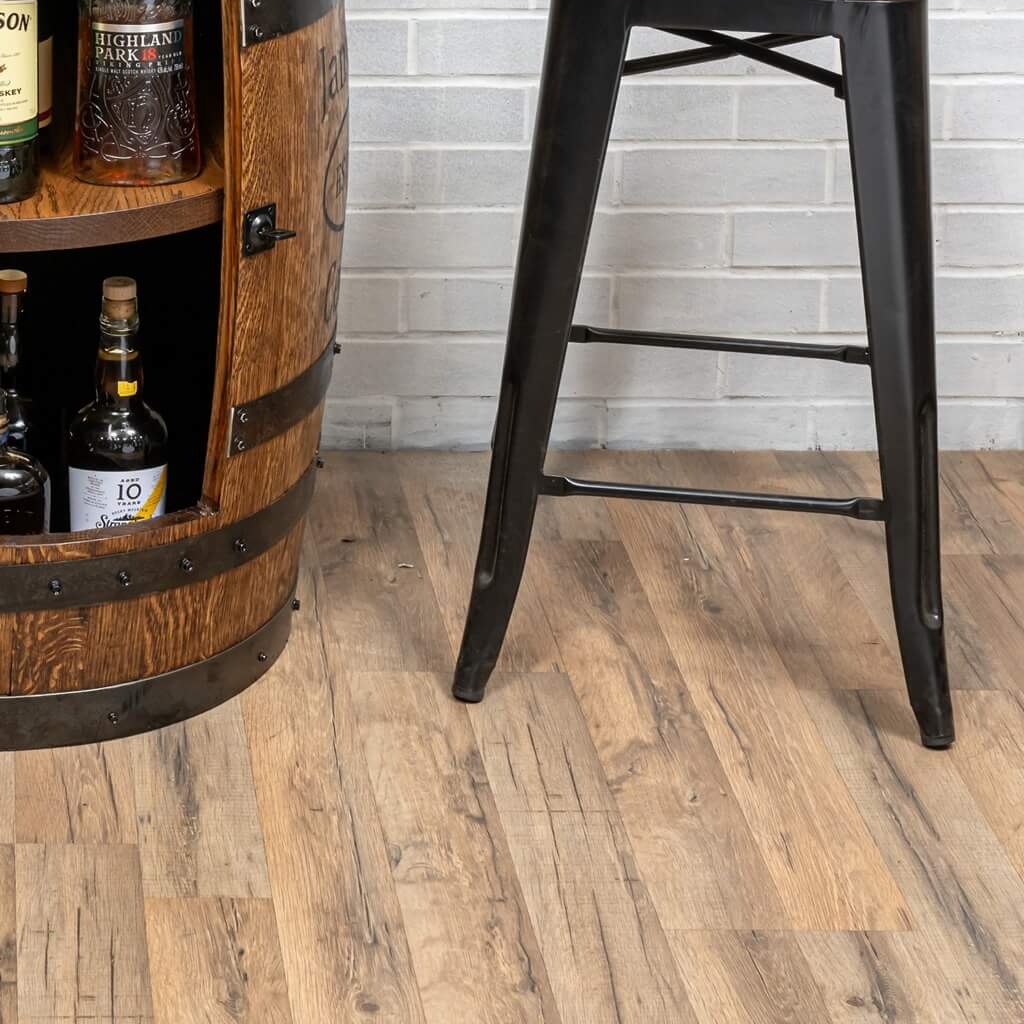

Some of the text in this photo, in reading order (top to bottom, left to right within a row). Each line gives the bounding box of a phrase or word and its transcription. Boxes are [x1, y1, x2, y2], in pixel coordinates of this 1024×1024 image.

[95, 31, 182, 47] HIGHLAND
[95, 46, 139, 65] PARK
[141, 47, 158, 61] 18
[117, 483, 142, 501] 10
